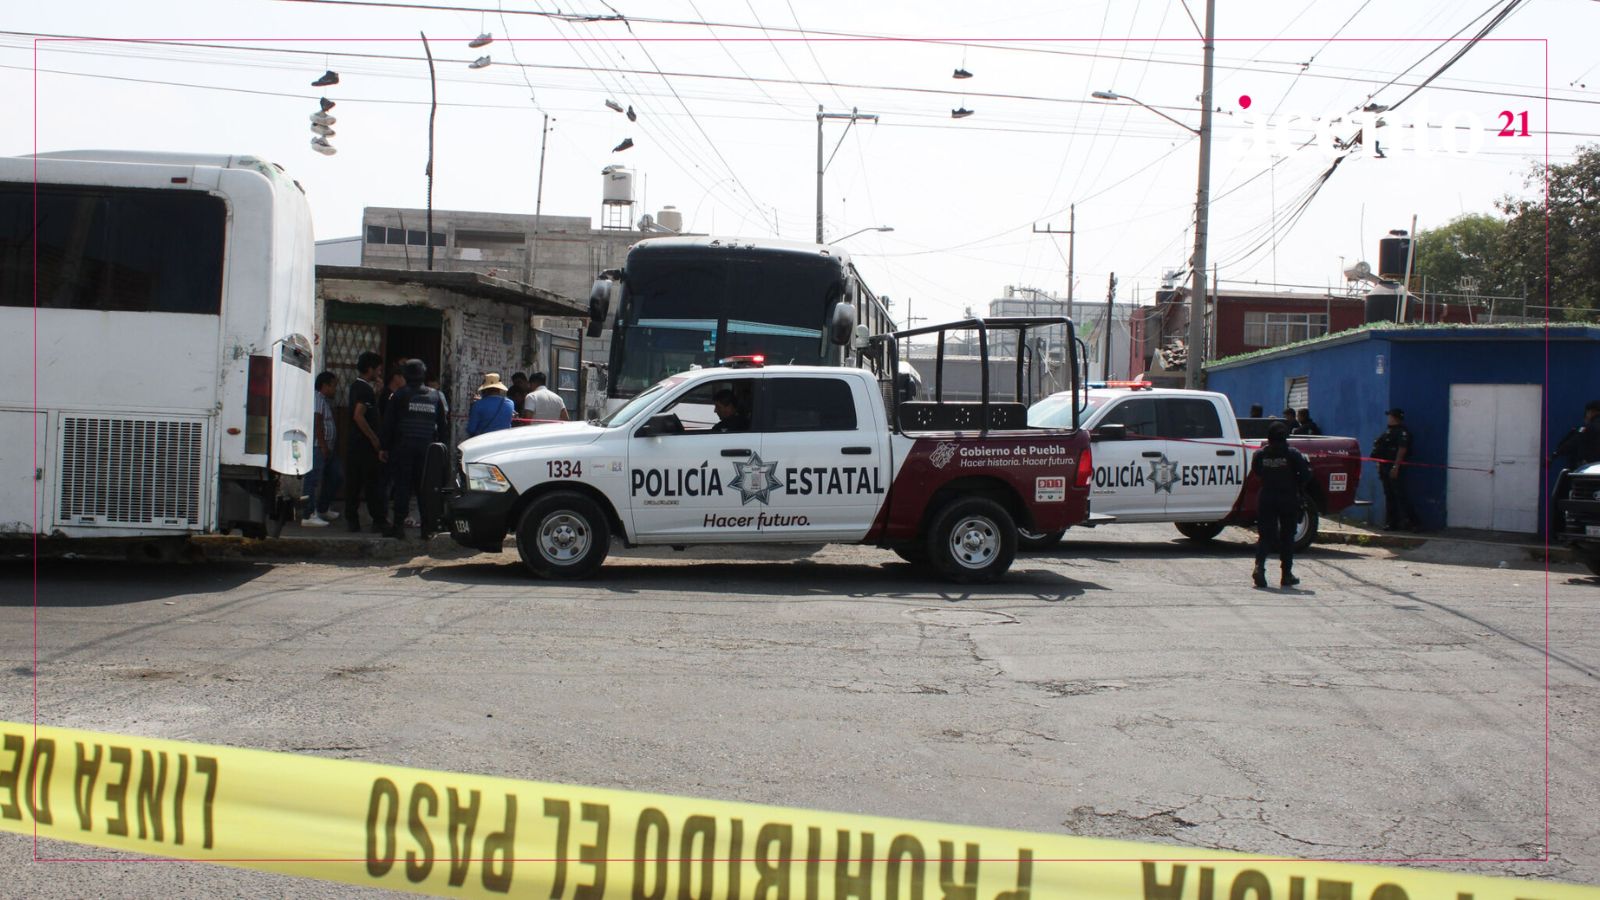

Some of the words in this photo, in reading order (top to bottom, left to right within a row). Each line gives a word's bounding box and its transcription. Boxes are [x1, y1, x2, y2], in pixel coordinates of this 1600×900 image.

[960, 446, 1009, 457] Gobierno
[1013, 446, 1027, 456] de
[1029, 445, 1066, 455] Puebla
[960, 459, 986, 468] Hacer
[987, 458, 1021, 467] historia.
[1022, 458, 1048, 466] Hacer
[1048, 457, 1076, 467] futuro.
[546, 460, 582, 478] 1334
[631, 459, 723, 497] POLICÍA
[785, 466, 885, 496] ESTATAL
[1181, 464, 1243, 487] ESTATAL
[1038, 479, 1063, 488] 911
[703, 512, 753, 529] Hacer
[757, 511, 811, 531] futuro.
[0, 734, 56, 825] DE
[74, 741, 218, 849] LINEA
[366, 777, 518, 894] PASO
[543, 797, 610, 900] EL
